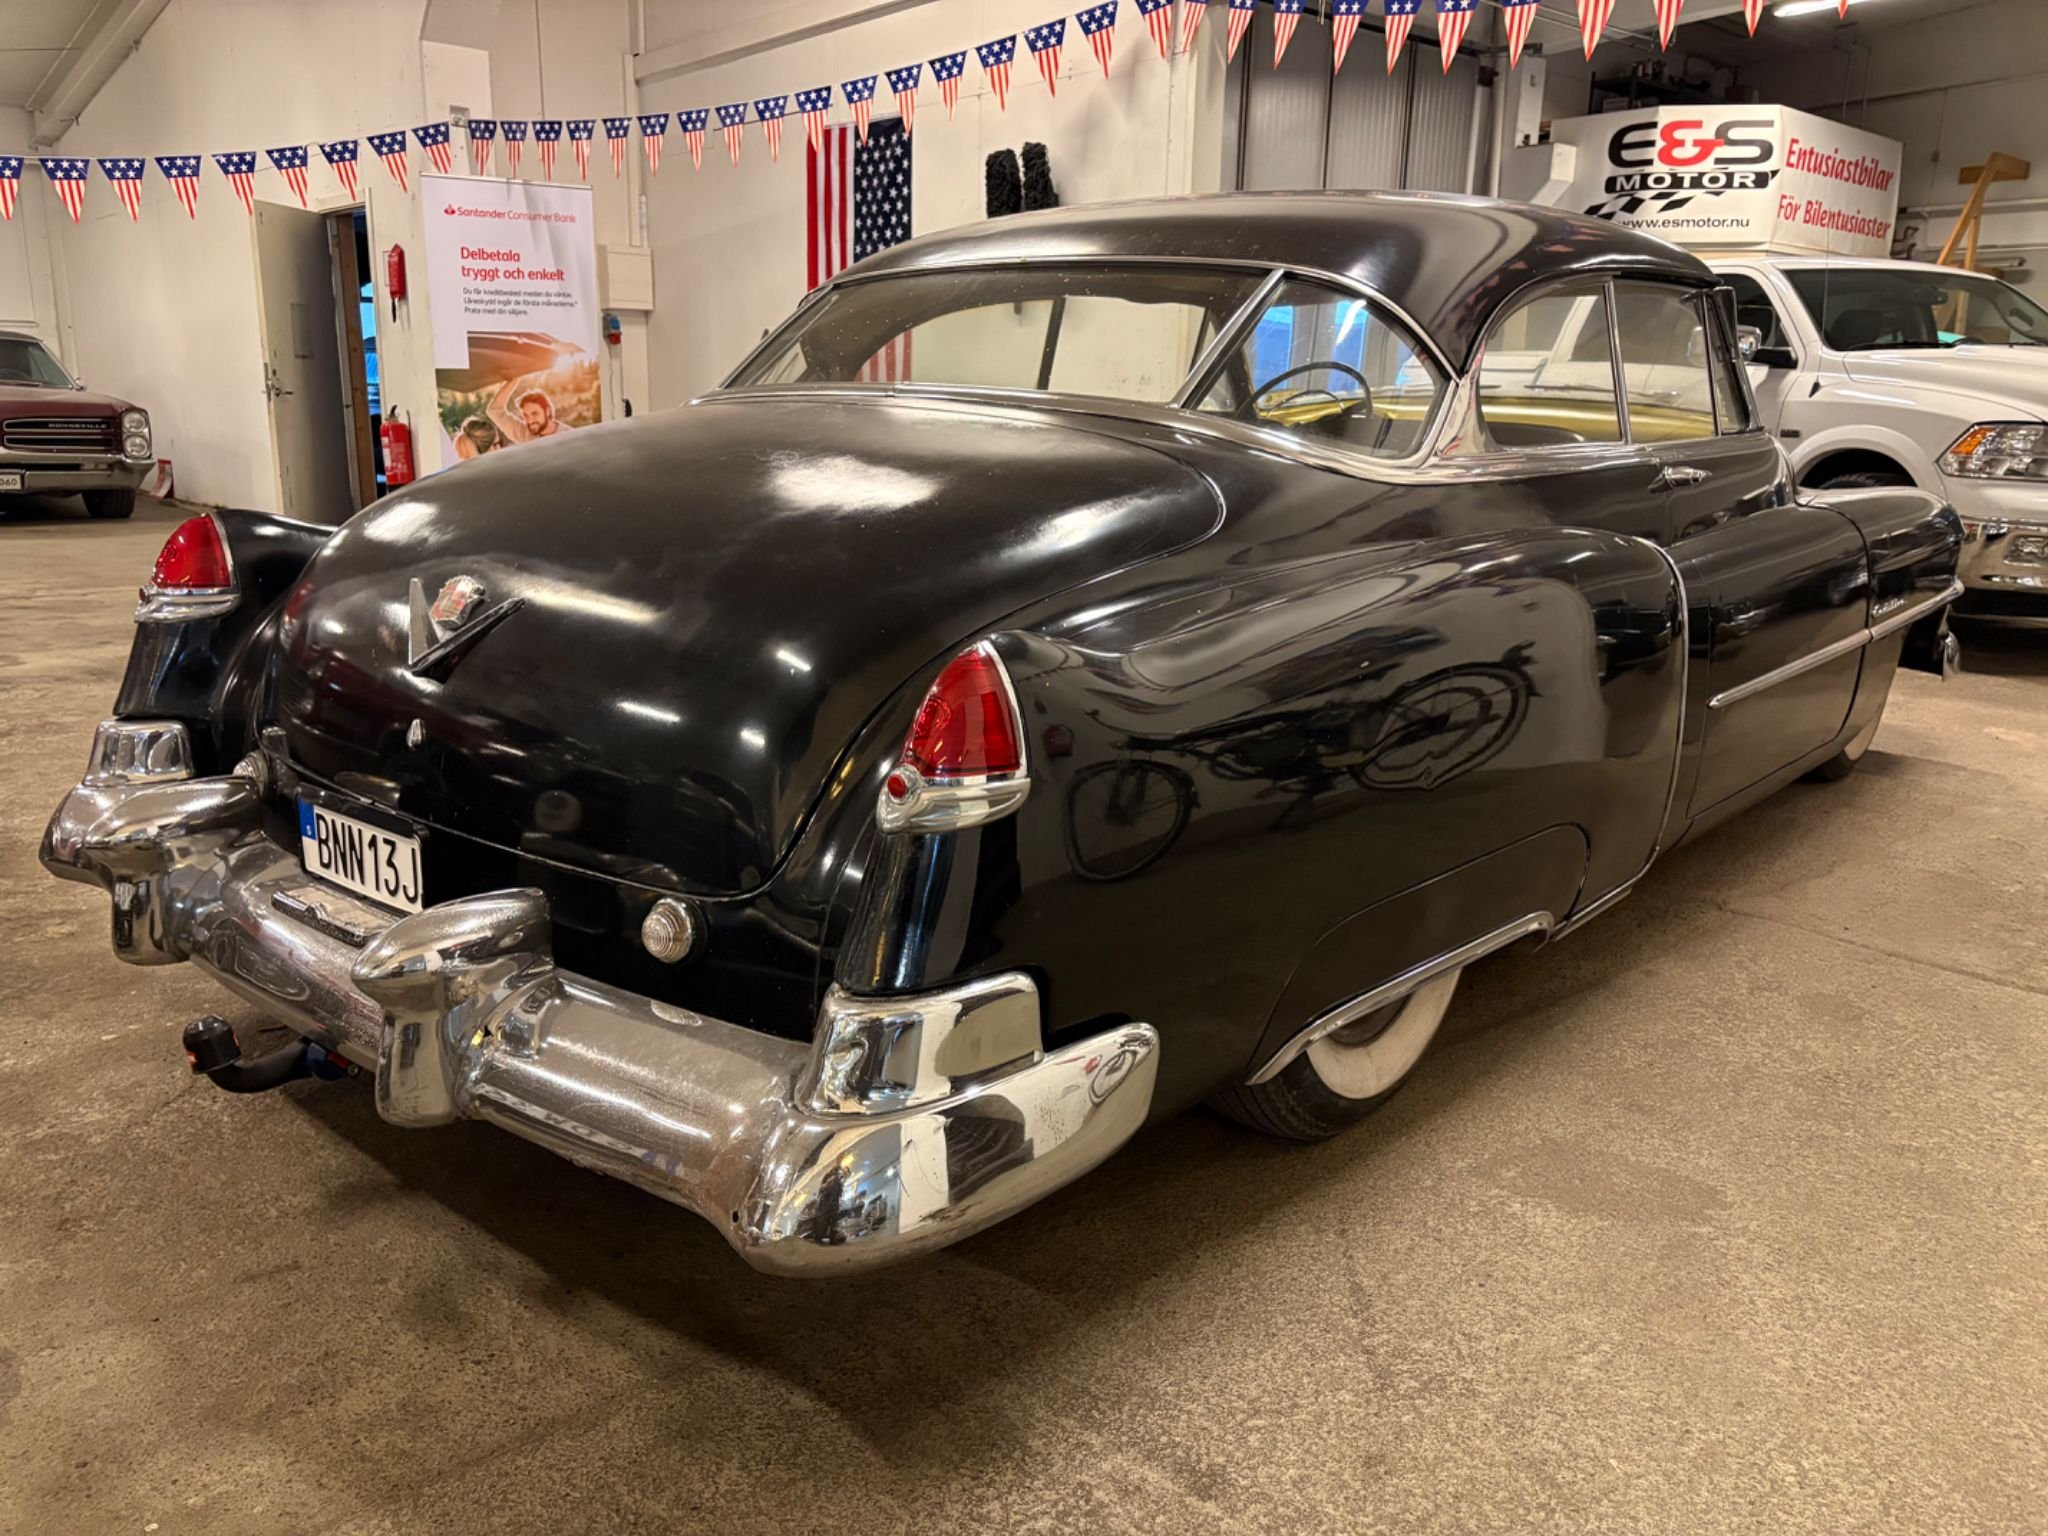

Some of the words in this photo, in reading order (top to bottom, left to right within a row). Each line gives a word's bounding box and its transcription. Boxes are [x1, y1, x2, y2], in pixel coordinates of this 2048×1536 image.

[1607, 120, 1775, 168] E&S
[1785, 137, 1894, 192] Entusiastbilar
[1615, 172, 1756, 191] MOTOR
[457, 207, 506, 219] Santander
[507, 210, 553, 221] Consumer
[554, 213, 576, 223] Bank
[1777, 194, 1801, 222] För
[1803, 200, 1891, 240] Bilentusiaster
[460, 246, 520, 262] Delbetala
[461, 265, 500, 281] tryggt
[503, 267, 525, 280] och
[527, 268, 565, 281] enkelt
[464, 297, 496, 306] Låneskydd
[497, 298, 512, 307] ingår
